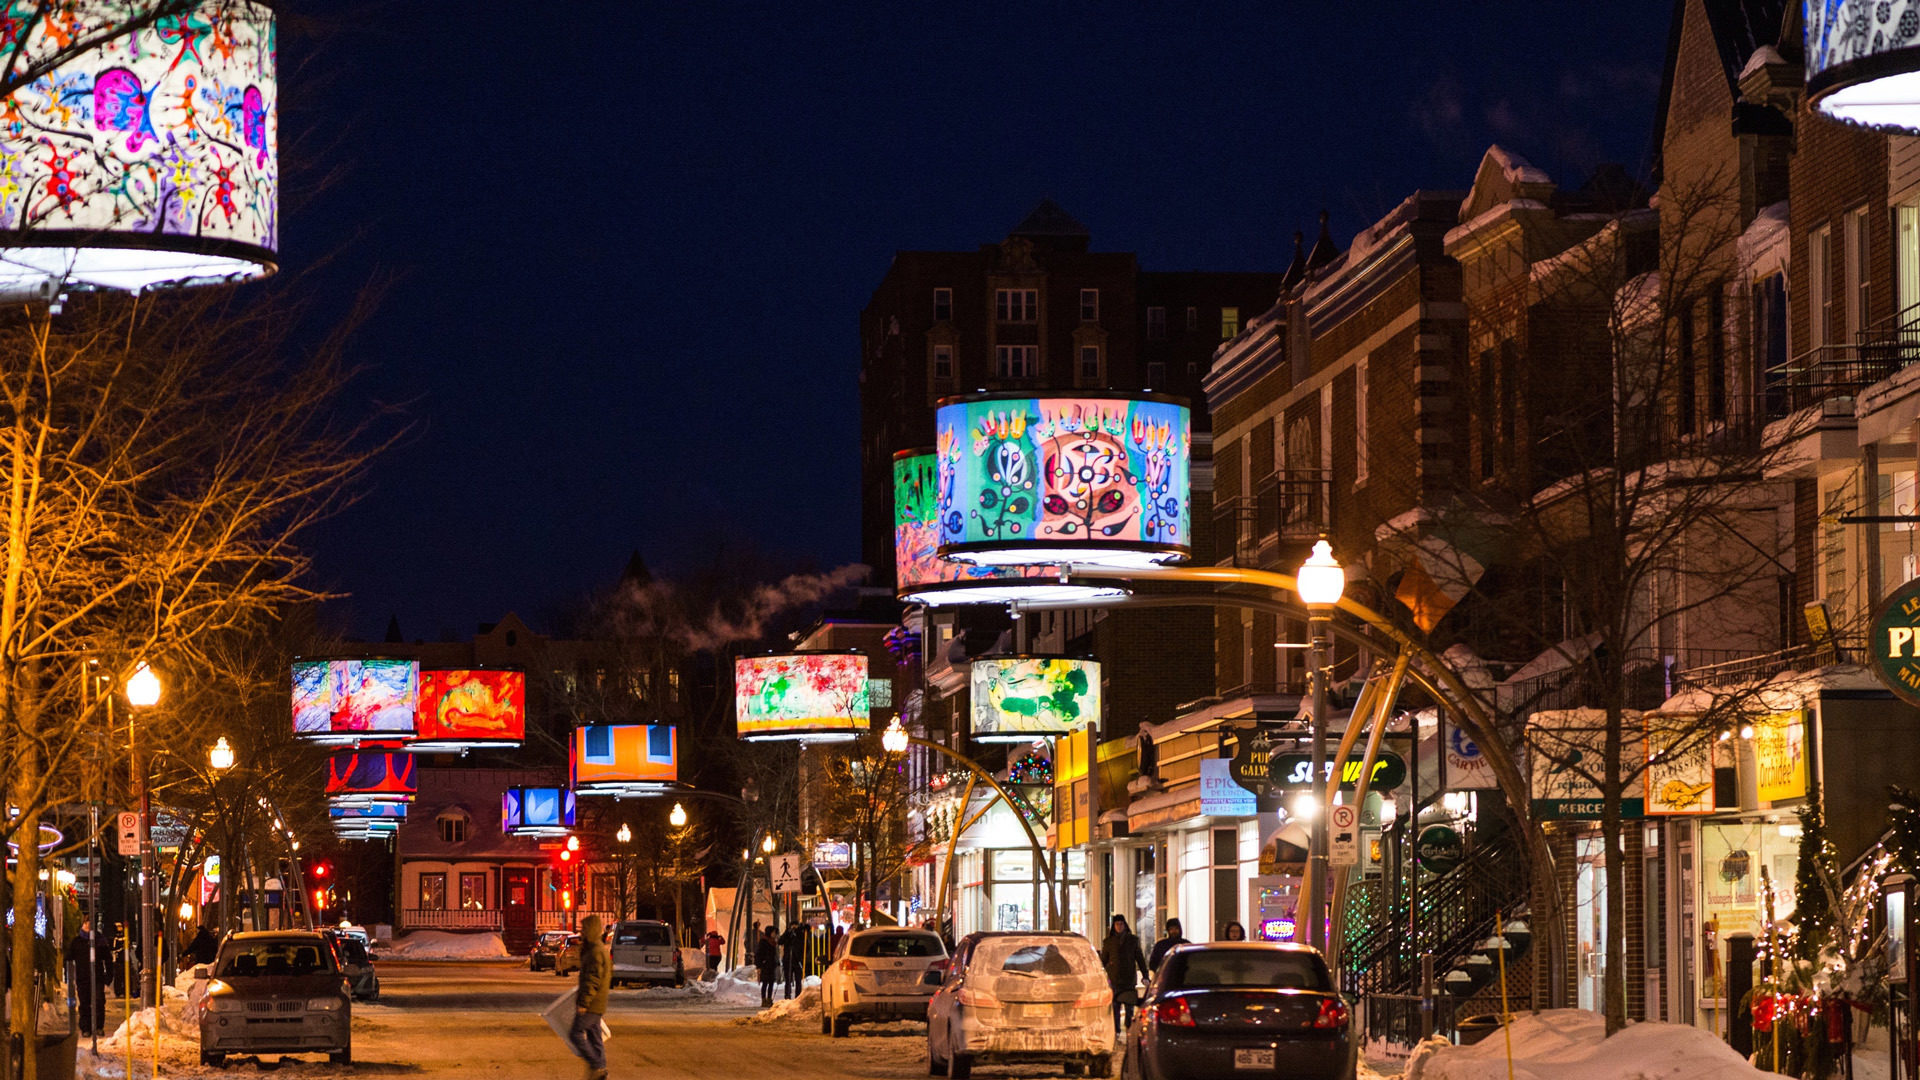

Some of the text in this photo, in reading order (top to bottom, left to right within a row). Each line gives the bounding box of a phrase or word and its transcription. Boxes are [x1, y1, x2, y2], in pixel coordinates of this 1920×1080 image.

[1447, 753, 1488, 770] CARTIE
[1206, 776, 1241, 789] ÉPIC
[1559, 803, 1622, 814] MERCE
